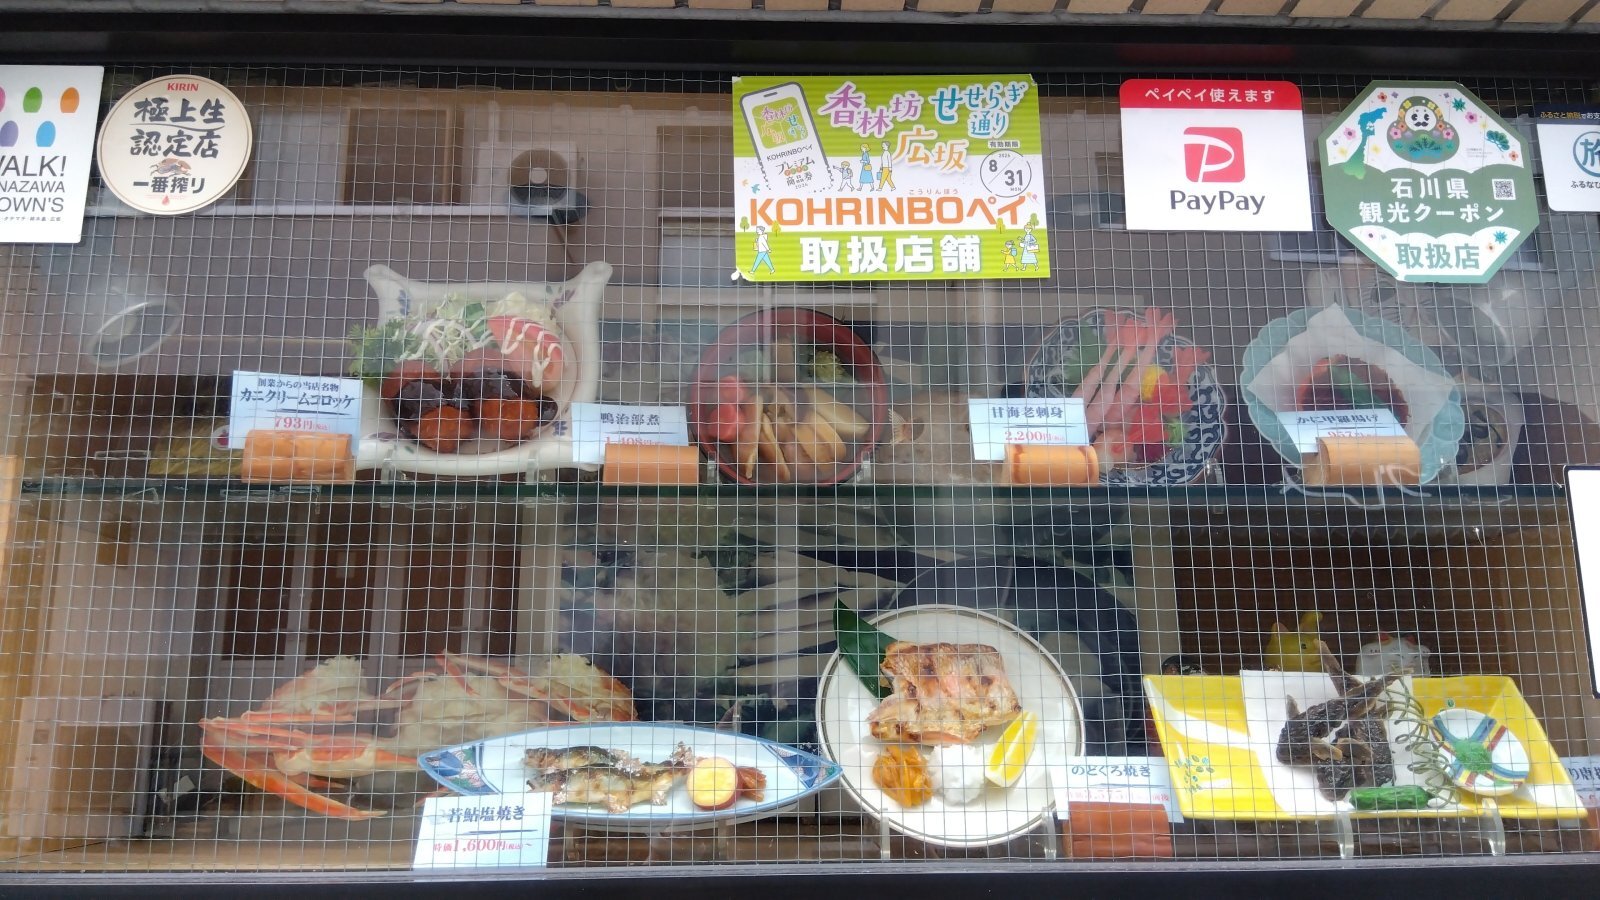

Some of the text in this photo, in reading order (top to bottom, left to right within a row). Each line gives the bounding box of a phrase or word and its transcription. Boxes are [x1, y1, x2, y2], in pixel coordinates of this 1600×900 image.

[167, 82, 199, 92] KIRIN
[1145, 88, 1275, 103] ペイペイ使えます
[134, 97, 226, 124] 極上生
[821, 84, 921, 135] 香林坊
[931, 83, 1026, 121] せせらぎ
[970, 111, 1006, 136] 通り
[129, 129, 222, 159] 認定店
[766, 144, 813, 162] KOHRINBOペイ
[893, 128, 967, 171] 広坂
[776, 156, 815, 175] プレミアム
[989, 160, 998, 172] 8
[133, 176, 205, 194] 一番搾り
[1004, 170, 1023, 186] 31
[1391, 177, 1469, 200] 石川県
[750, 195, 1026, 226] KOHRINBOペイ
[1170, 190, 1266, 215] PayPay
[1359, 201, 1504, 224] 観光クーポン
[800, 235, 981, 274] 取扱店舗
[1395, 243, 1480, 270] 取扱店
[258, 378, 340, 393] 創業からの当店名物
[240, 387, 355, 409] カニクリームコロッケ
[600, 412, 661, 426] 鴨治部煮
[992, 406, 1064, 419] 甘海老刺身
[1071, 764, 1151, 777] のどくろ焼き
